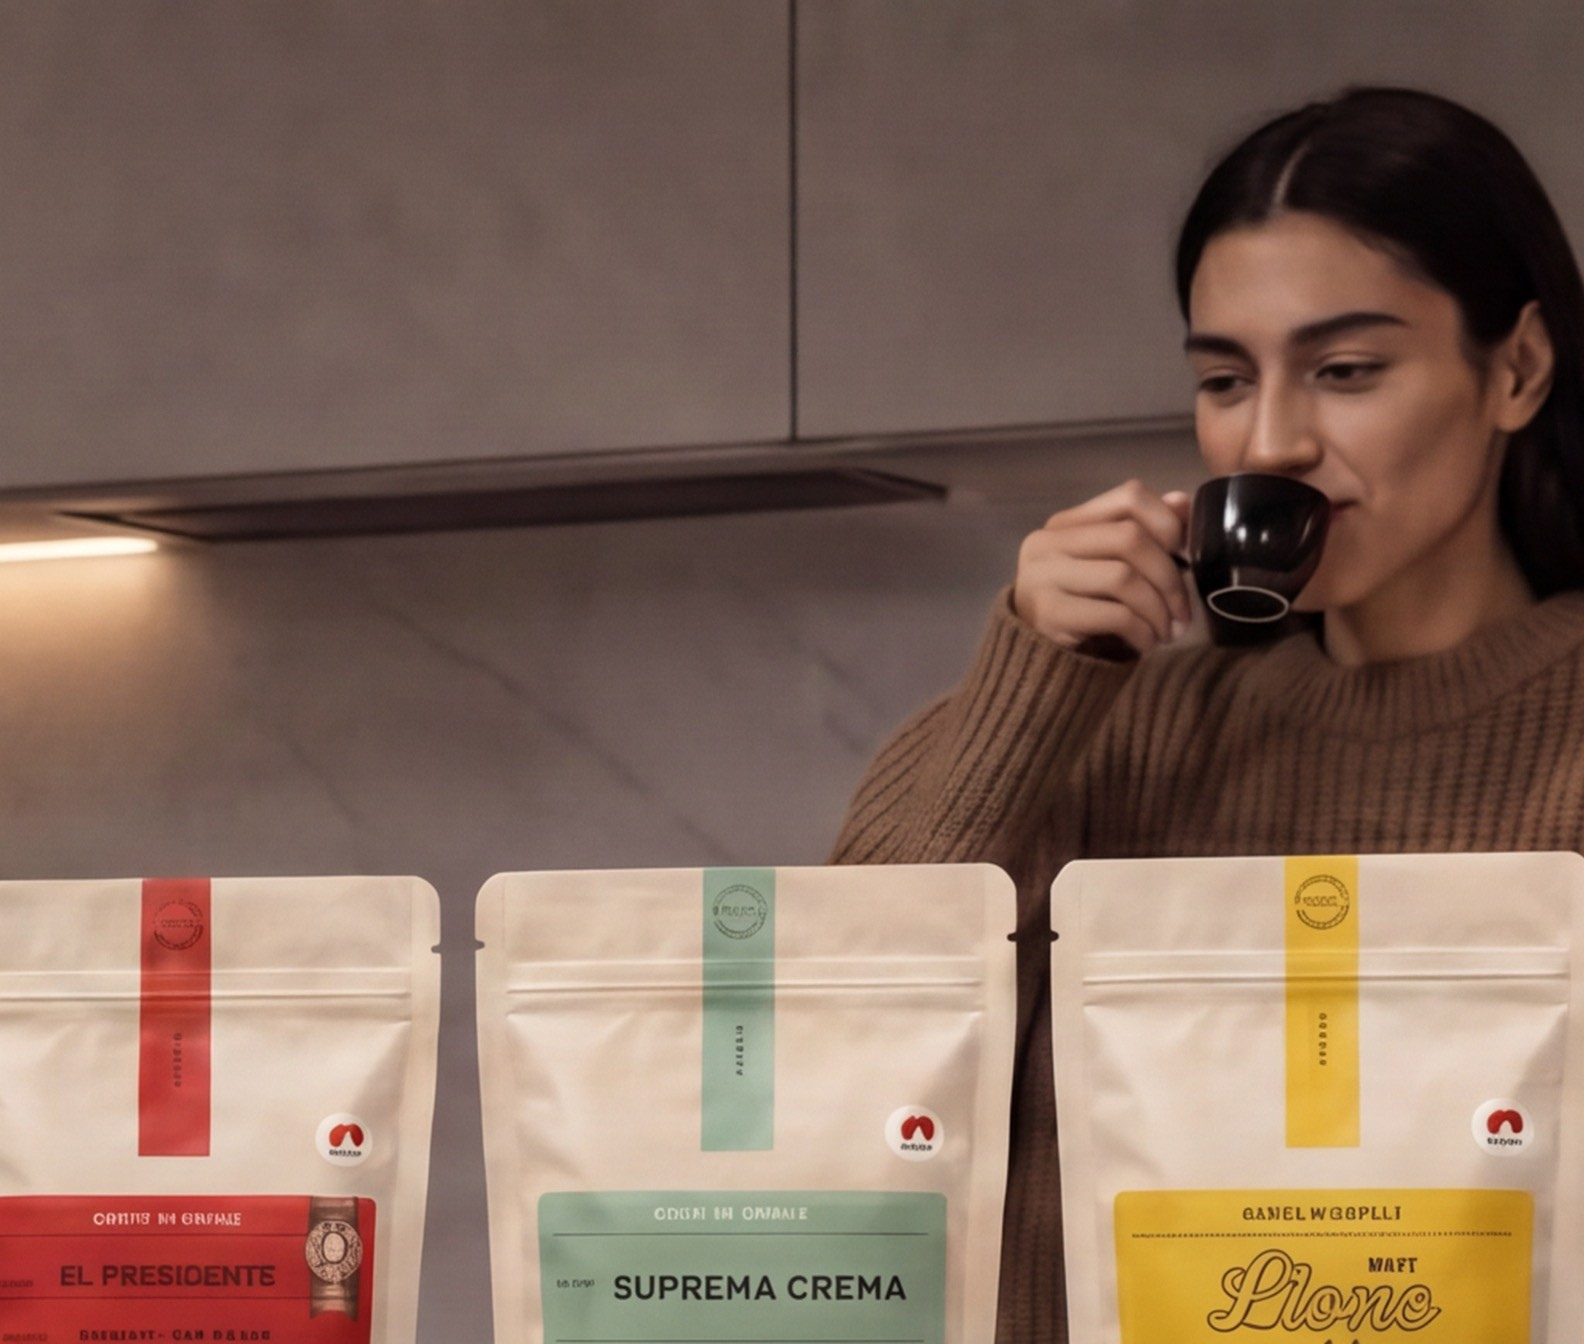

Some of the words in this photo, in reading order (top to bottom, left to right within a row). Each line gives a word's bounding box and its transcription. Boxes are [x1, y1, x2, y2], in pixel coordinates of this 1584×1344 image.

[60, 1265, 94, 1287] EL
[101, 1264, 276, 1287] PRESIDENTE
[614, 1274, 777, 1301] SUPREMA
[787, 1274, 907, 1301] CREMA
